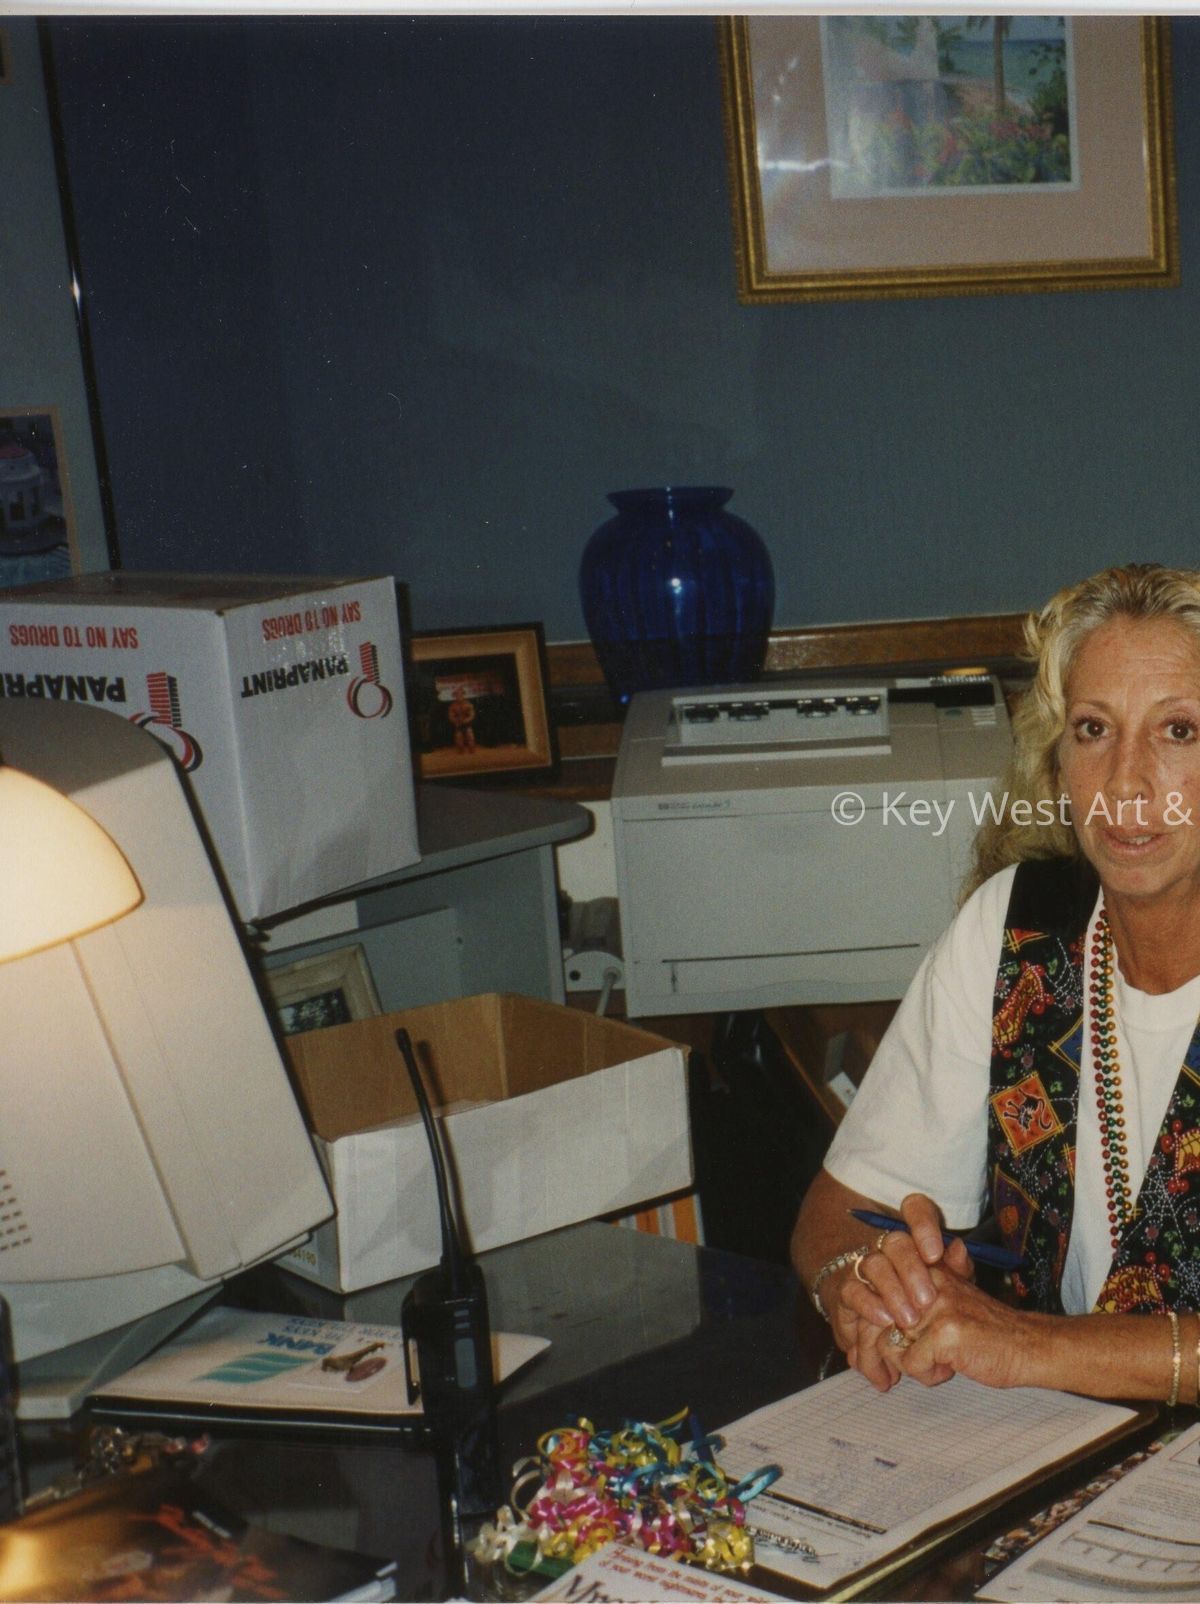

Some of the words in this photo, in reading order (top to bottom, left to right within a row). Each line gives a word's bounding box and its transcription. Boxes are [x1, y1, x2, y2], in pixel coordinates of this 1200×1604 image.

[305, 609, 320, 631] TO
[322, 605, 338, 628] NO
[342, 601, 361, 624] SAY
[9, 624, 60, 646] DRUGS
[63, 626, 82, 647] TO
[86, 626, 107, 648] NO
[112, 627, 139, 648] SAY
[262, 613, 303, 641] DRUGS
[241, 653, 349, 698] PANAPRINT
